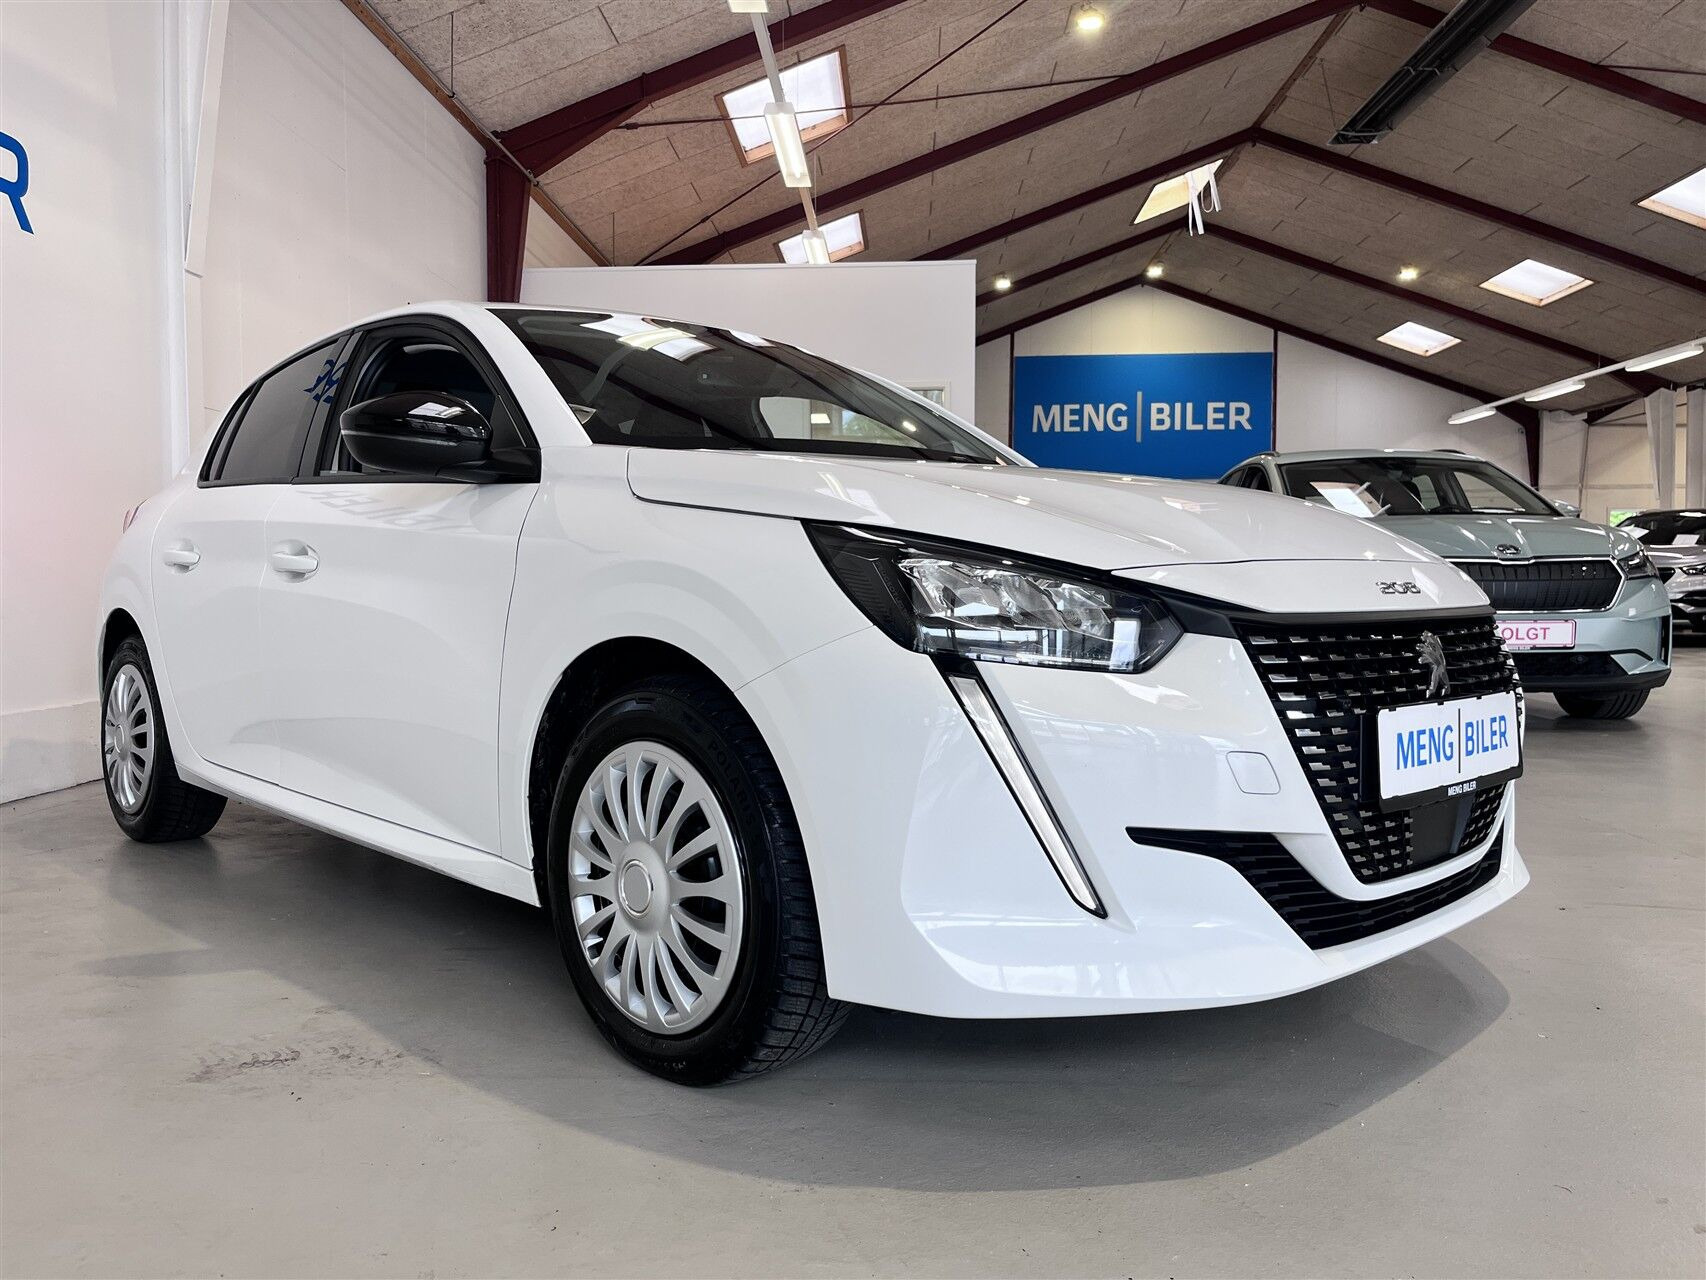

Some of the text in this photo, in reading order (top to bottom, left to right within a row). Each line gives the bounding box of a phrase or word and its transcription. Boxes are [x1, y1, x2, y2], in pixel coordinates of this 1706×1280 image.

[1031, 401, 1252, 433] MENG BILER
[1375, 581, 1421, 594] 208
[1501, 627, 1551, 641] OLGT
[1396, 715, 1509, 770] MENG BILER
[1447, 780, 1477, 796] MENG BILER
